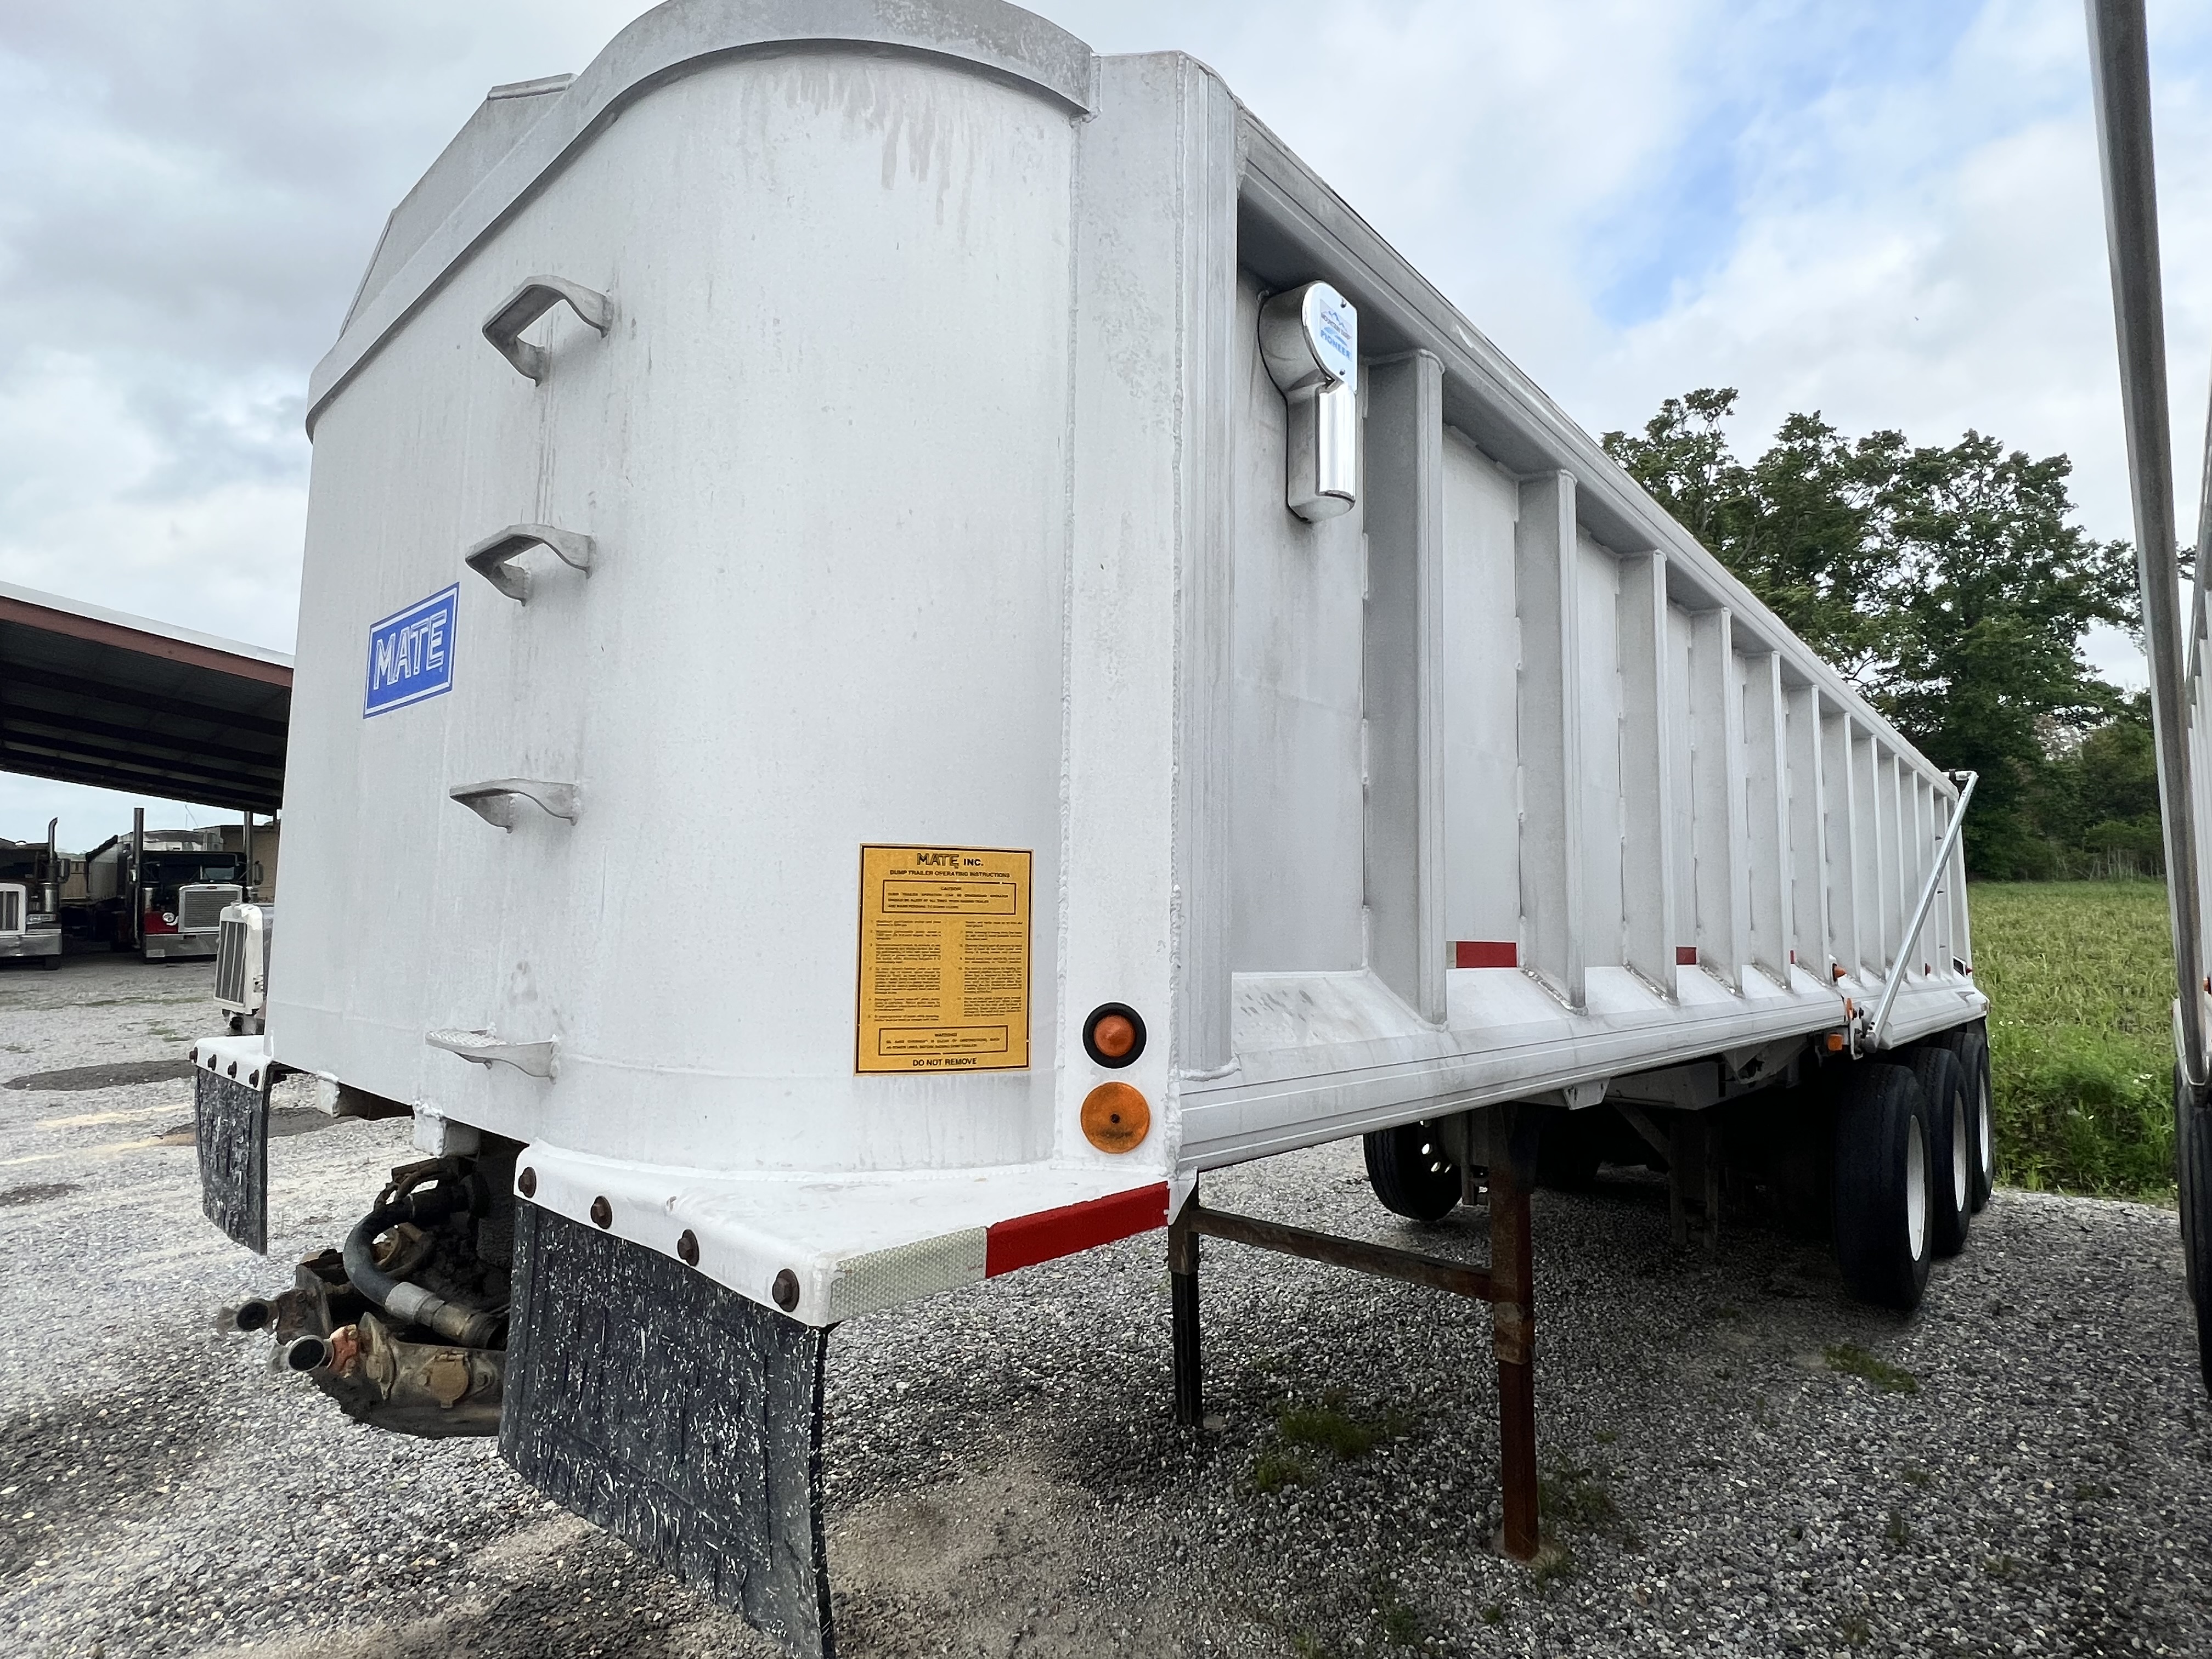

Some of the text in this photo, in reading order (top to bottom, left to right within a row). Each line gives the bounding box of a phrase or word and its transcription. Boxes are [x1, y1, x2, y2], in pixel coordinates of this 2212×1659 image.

[1321, 329, 1350, 359] PIONEER
[374, 609, 447, 690] MATE
[917, 853, 959, 868] MATE
